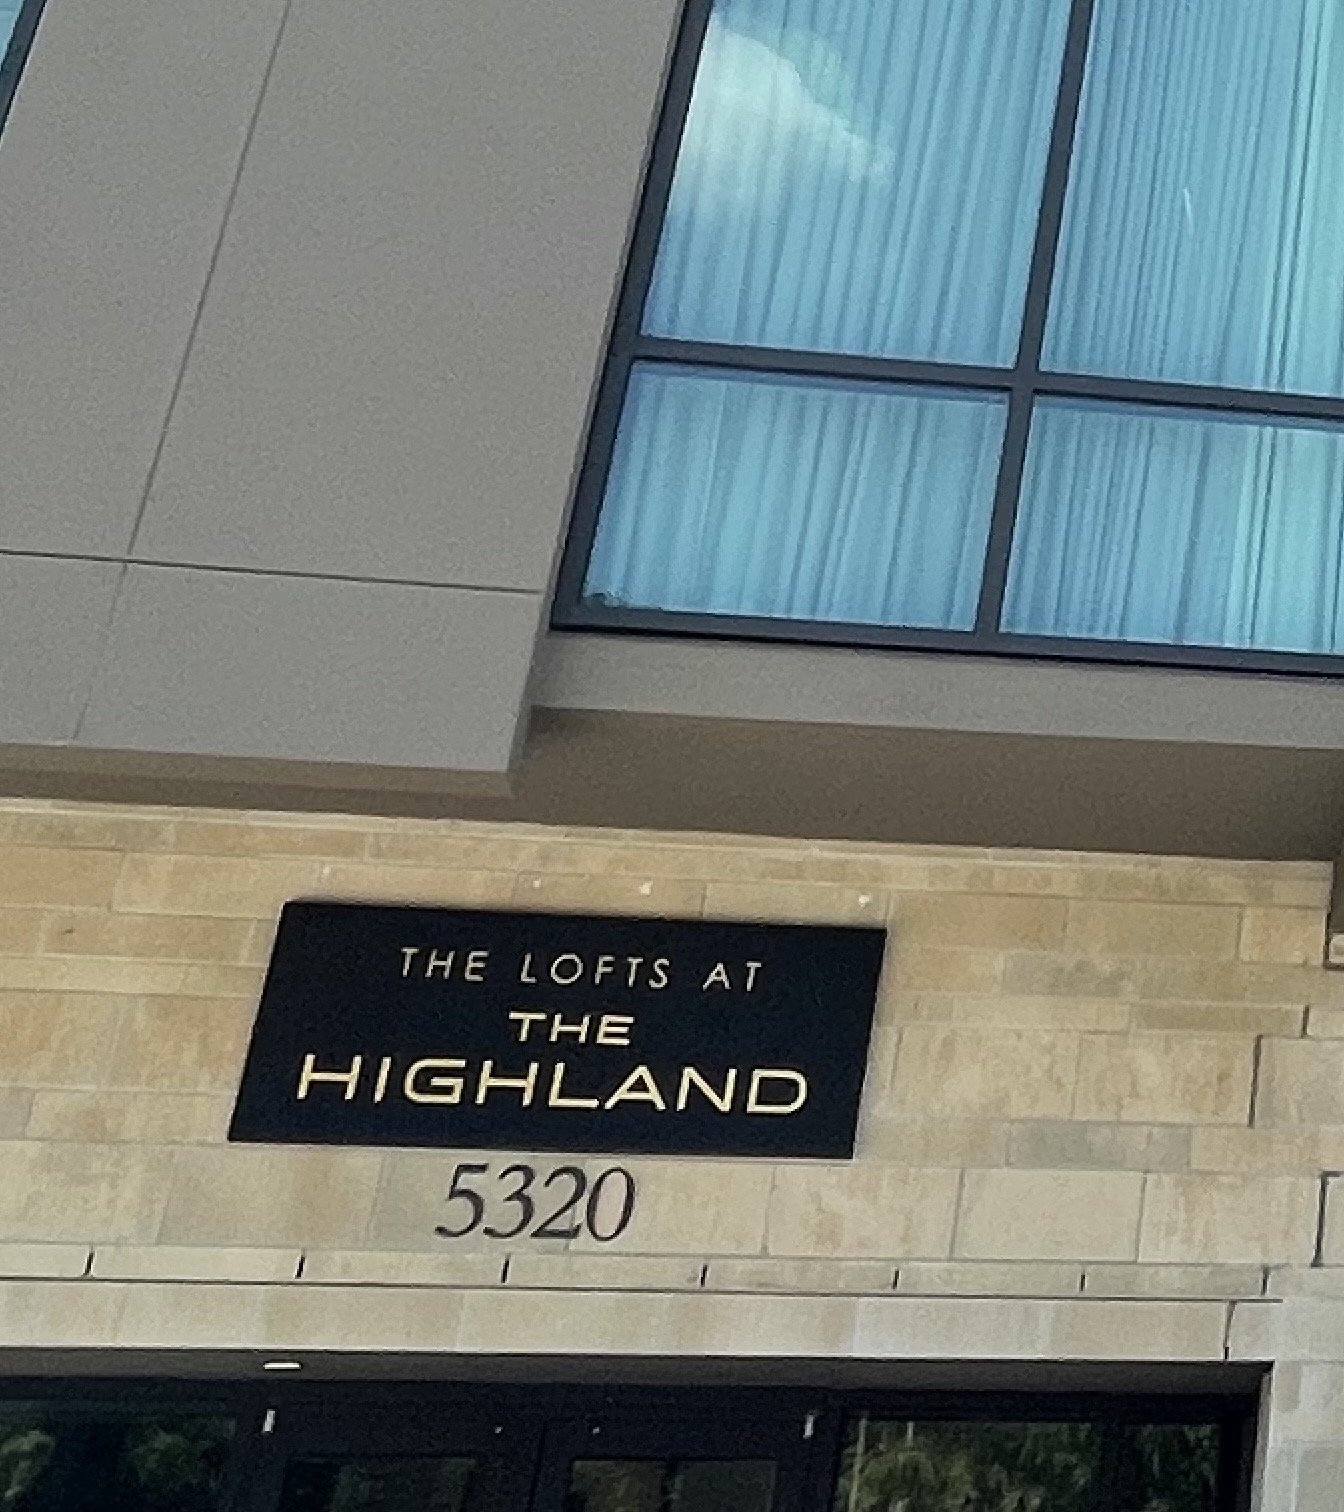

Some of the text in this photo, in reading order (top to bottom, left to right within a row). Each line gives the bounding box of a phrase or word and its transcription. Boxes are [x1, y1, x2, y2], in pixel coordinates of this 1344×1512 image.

[401, 946, 763, 992] THE LOFTS AT
[508, 1010, 635, 1047] THE
[296, 1053, 809, 1115] HIGHLAND
[434, 1163, 637, 1243] 5320
